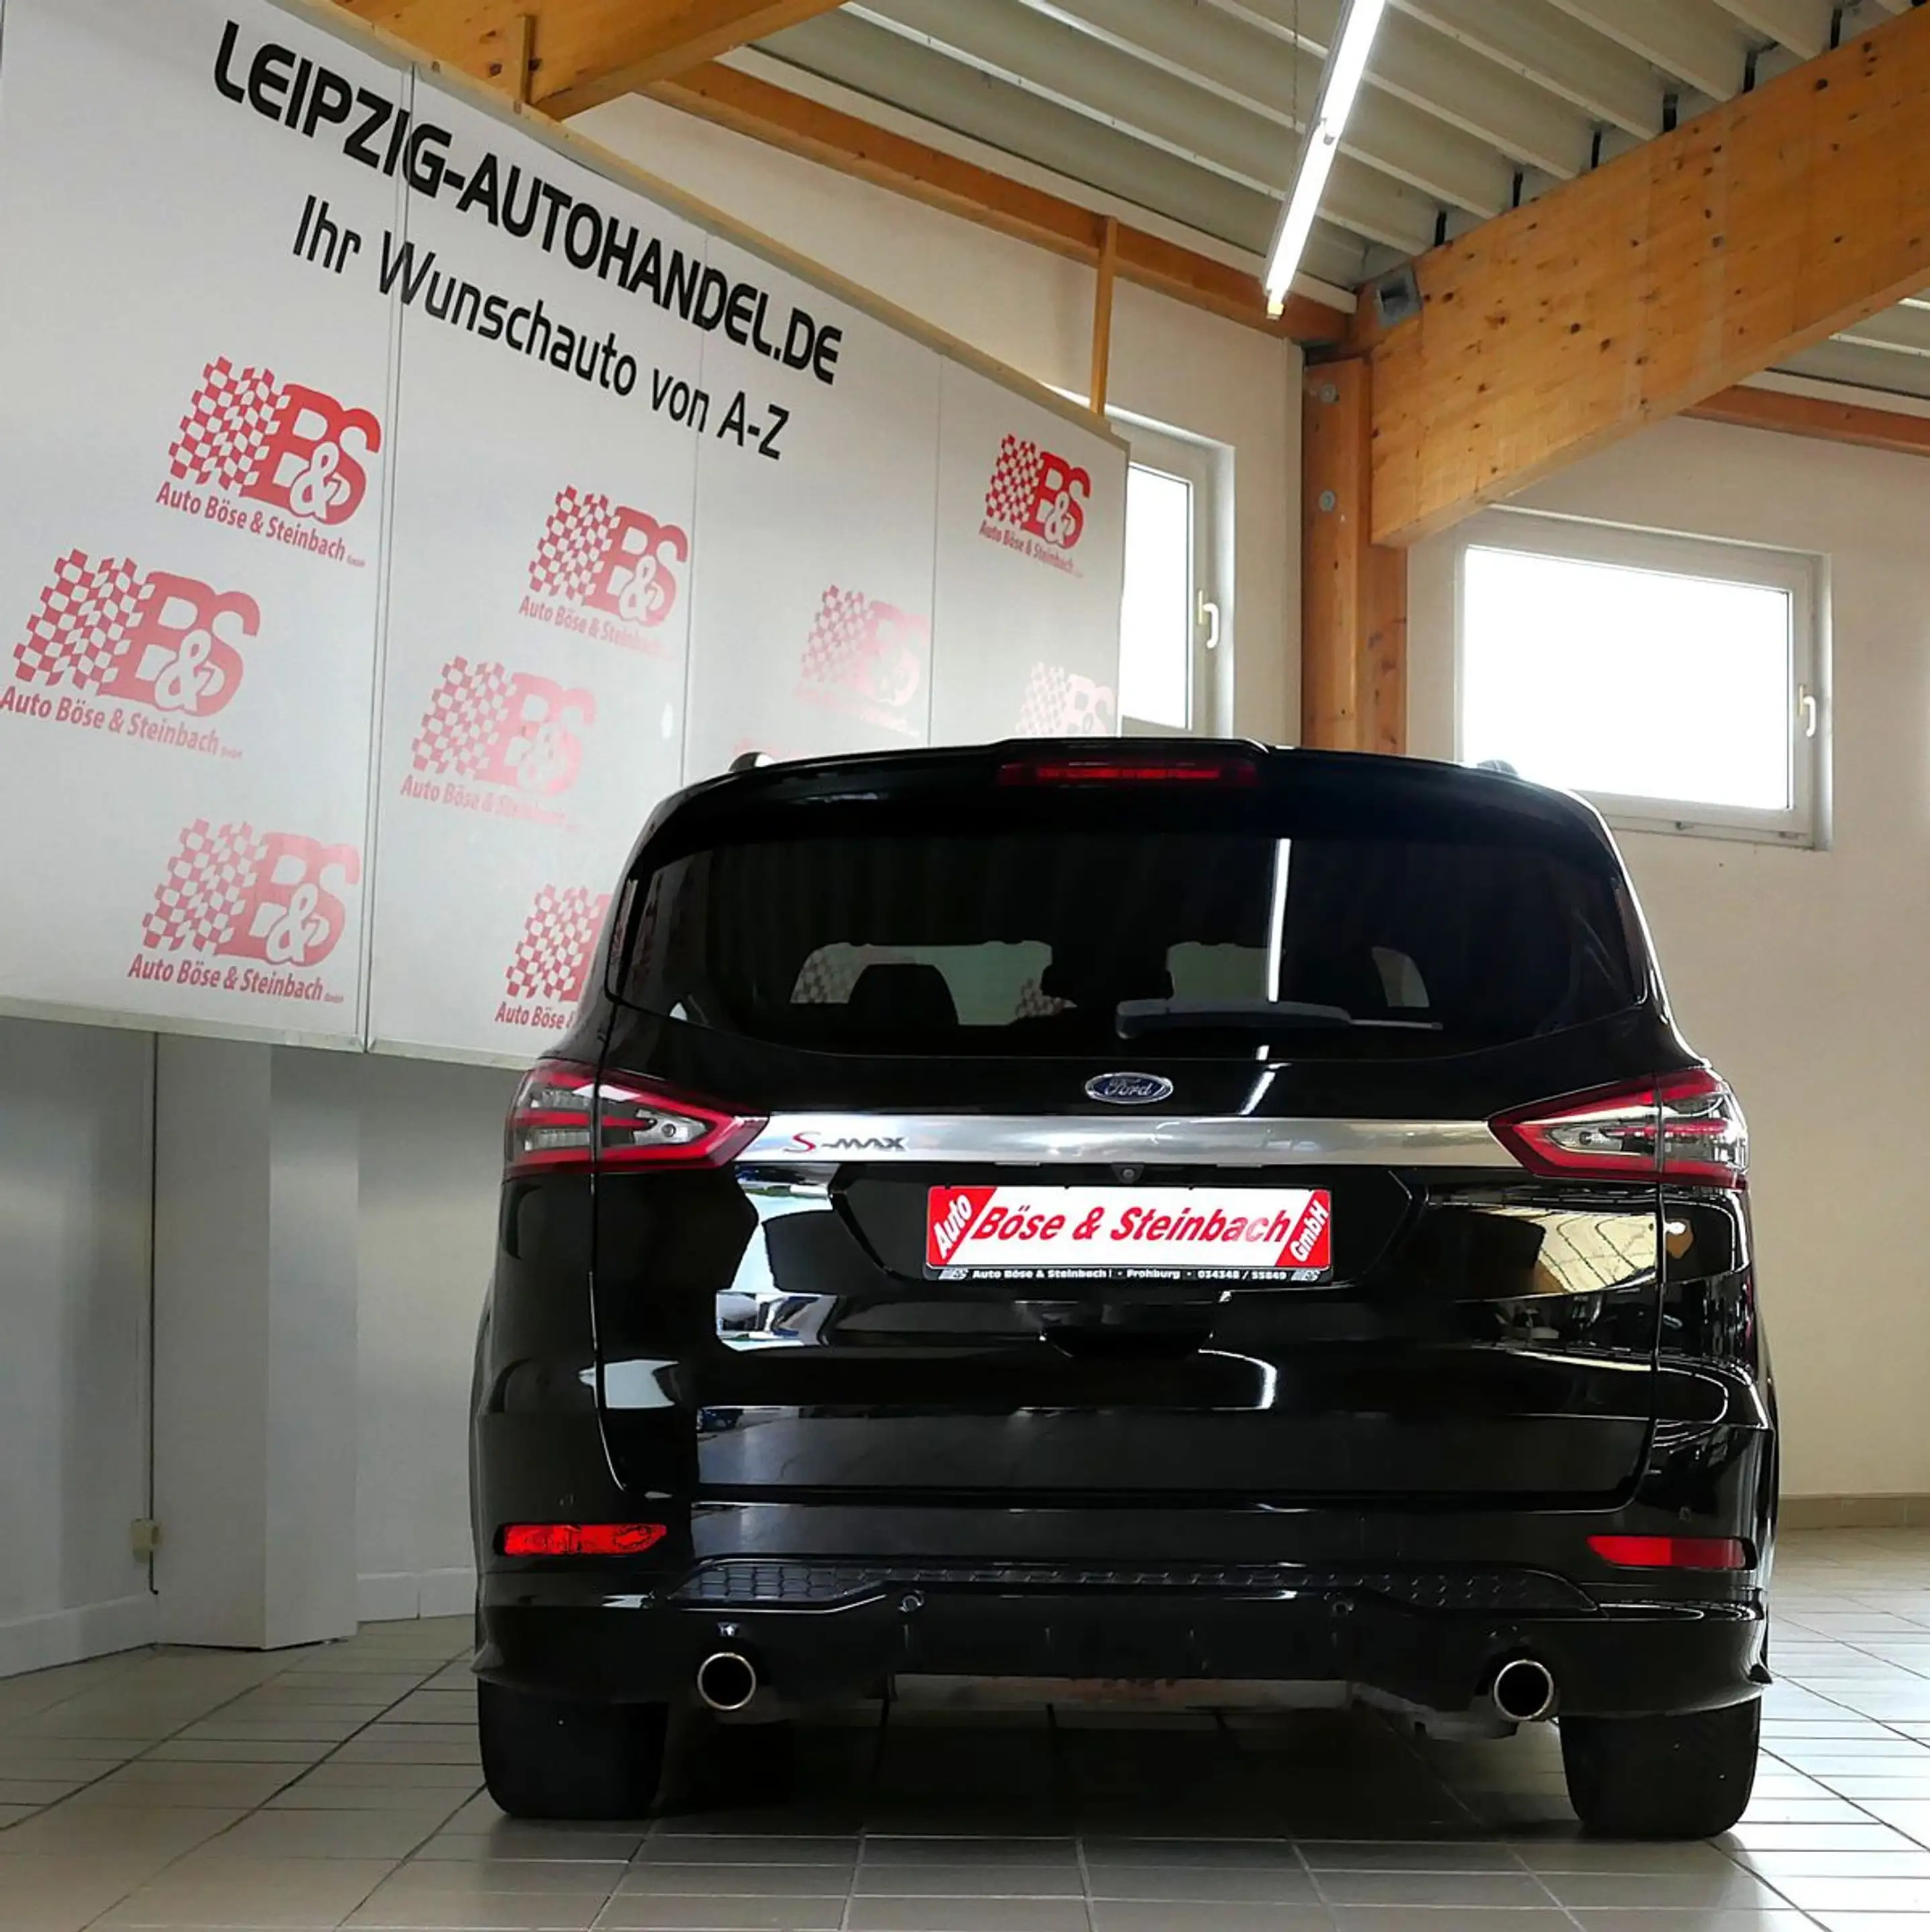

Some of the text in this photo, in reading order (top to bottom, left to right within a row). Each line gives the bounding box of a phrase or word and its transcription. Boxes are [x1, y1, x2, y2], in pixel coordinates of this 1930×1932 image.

[213, 19, 843, 386] LEIPZIG-AUTOHANDEL.DE
[292, 195, 790, 461] Ihr Wunschauto von A-Z
[239, 383, 382, 526] B&S
[156, 481, 346, 562] Auto Böse & Steinbach
[1020, 450, 1091, 550] B&S
[582, 505, 688, 627] B&S
[96, 571, 261, 717] B&S
[519, 594, 553, 622] Auto
[554, 605, 585, 634] Böse
[0, 686, 52, 718] Auto
[55, 696, 105, 729] Böse
[108, 708, 125, 734] &
[127, 712, 220, 756] Steinbach
[400, 773, 441, 802] Auto
[213, 831, 361, 967] B&S
[127, 953, 324, 1001] Auto Böse & Steinbach
[494, 1000, 529, 1026] Auto
[531, 1005, 565, 1030] Böse
[1104, 1078, 1153, 1096] Ford
[933, 1193, 1329, 1262] Auto Böse & Steinbach GmbH
[973, 1269, 1002, 1279] Auto
[1047, 1269, 1107, 1279] Steinbach
[1126, 1269, 1181, 1280] Frohburg
